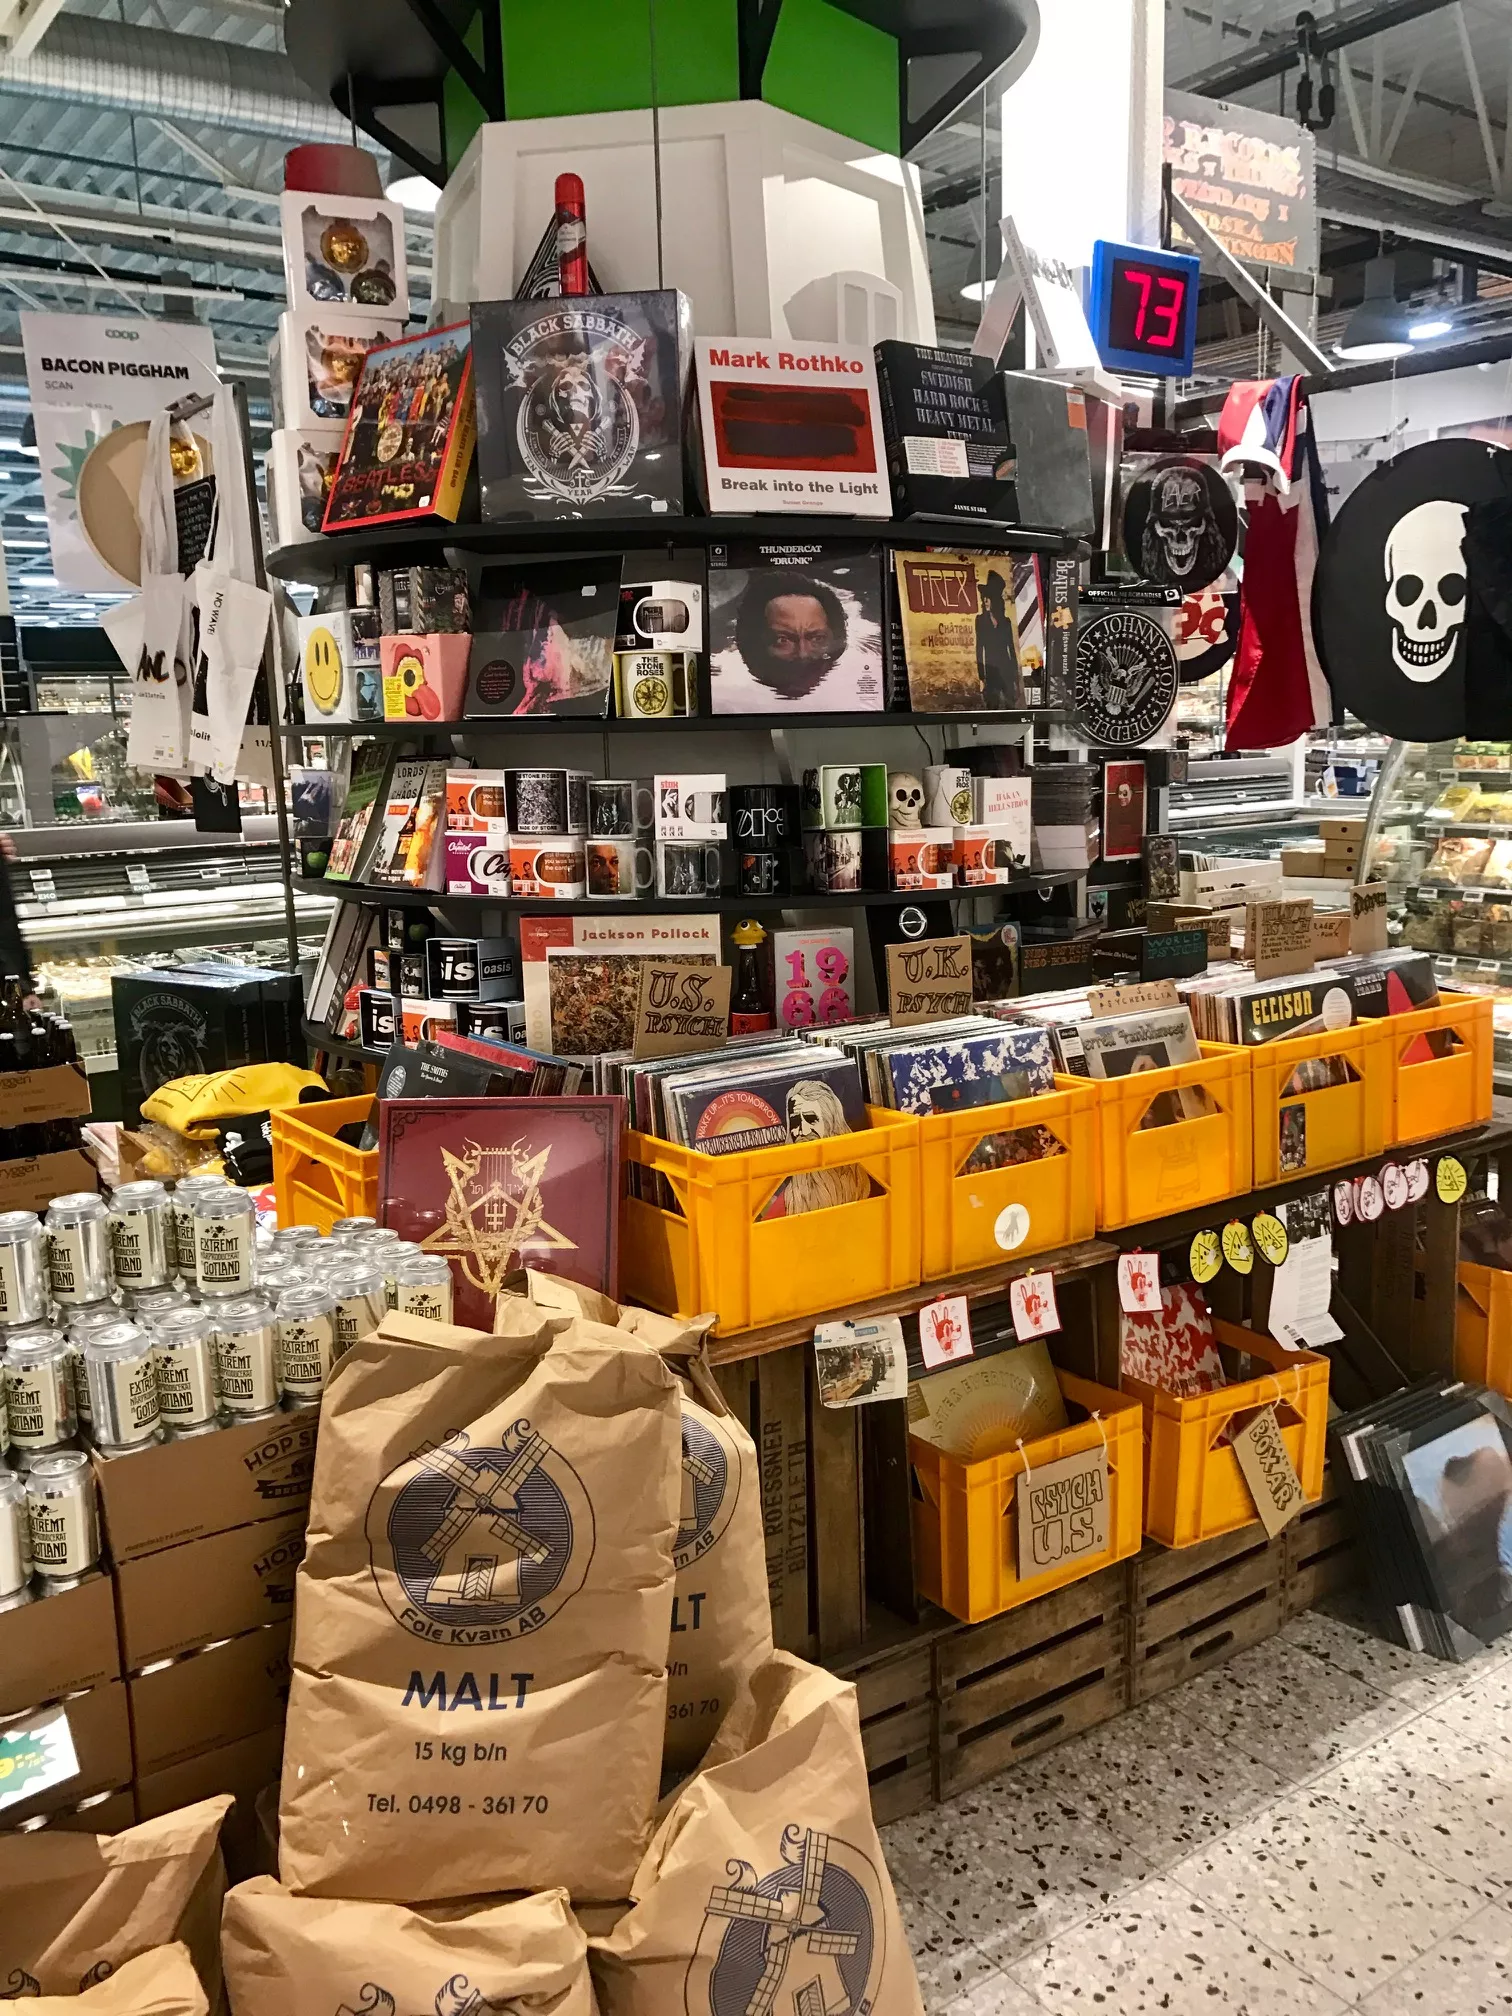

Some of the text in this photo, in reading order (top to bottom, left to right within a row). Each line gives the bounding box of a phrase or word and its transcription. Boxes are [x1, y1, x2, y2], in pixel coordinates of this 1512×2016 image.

[1124, 270, 1186, 348] 73
[105, 329, 139, 341] coop
[510, 313, 638, 356] BLACK SABBATH
[709, 348, 864, 374] Mark Rothko
[914, 347, 934, 360] THE
[41, 357, 190, 380] BACON PIGGHAM
[45, 380, 74, 390] SCAN
[920, 370, 974, 392] SWEDISH
[912, 388, 981, 411] HARD ROCK
[916, 407, 996, 434] HEAVY METAL
[341, 460, 430, 492] BEATLES
[523, 453, 538, 473] TEN
[566, 488, 593, 497] YEAR
[622, 445, 638, 467] WAR
[721, 478, 879, 496] Break into the Light
[759, 544, 822, 554] THUNDERCAT
[1054, 560, 1076, 604] BEATLES
[212, 592, 224, 608] NO
[1103, 616, 1167, 654] JOHNNY
[1062, 631, 1070, 676] jigsaw puzzle
[636, 662, 664, 670] STONE
[1158, 664, 1174, 712] JOEY
[396, 764, 424, 778] LORDS
[390, 788, 418, 800] CHAOS
[402, 780, 412, 789] OF
[448, 842, 472, 852] Capitol
[582, 929, 645, 941] Jackson
[652, 928, 710, 940] Pollock
[1148, 932, 1202, 948] WORLD
[484, 962, 512, 975] oasis
[784, 946, 849, 988] 19
[898, 944, 969, 984] U.K.
[649, 970, 715, 1012] U.S.
[896, 992, 972, 1014] PSYCH
[134, 994, 202, 1024] BLACK SABBATH
[1252, 990, 1313, 1026] ELLISON
[372, 1009, 394, 1034] is
[645, 1012, 726, 1038] PSYCH
[420, 1062, 450, 1078] THE SMITHS
[698, 1113, 712, 1138] WAKE
[722, 1094, 736, 1106] IT'S
[736, 1093, 780, 1124] TOMORROW
[200, 1236, 240, 1252] EXTREMT
[204, 1260, 240, 1276] GOTLAND
[404, 1304, 442, 1319] EXTREMT
[282, 1339, 320, 1354] EXTREMT
[286, 1362, 322, 1378] GOTLAND
[243, 1431, 297, 1472] HOP
[1248, 1418, 1294, 1512] BOXAR
[762, 1418, 784, 1538] ROESSNER
[1032, 1468, 1105, 1525] PSYCH
[694, 1530, 714, 1554] AB
[1032, 1508, 1104, 1566] U.S.
[253, 1540, 301, 1578] HOP
[400, 1606, 546, 1644] Fole Kvarn AB
[400, 1670, 535, 1712] MALT
[700, 1698, 718, 1714] 70
[414, 1742, 508, 1766] 15 kg b/n
[367, 1794, 400, 1814] Tel.
[408, 1794, 462, 1814] 0498
[482, 1794, 516, 1814] 361
[522, 1794, 549, 1814] 70
